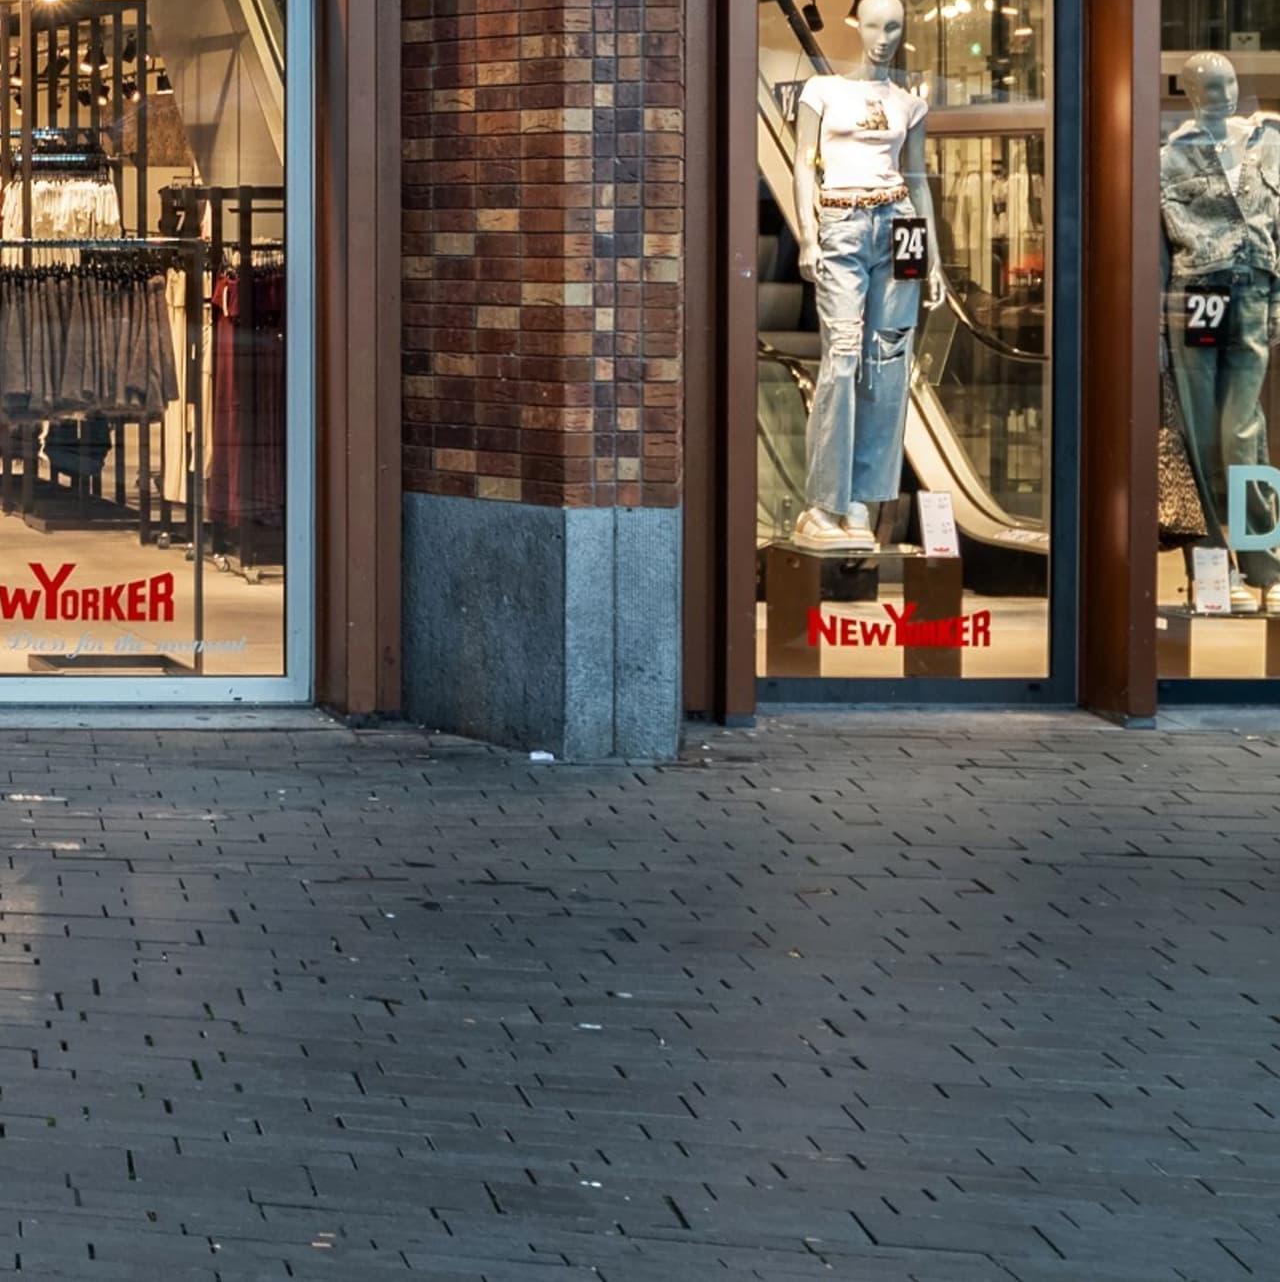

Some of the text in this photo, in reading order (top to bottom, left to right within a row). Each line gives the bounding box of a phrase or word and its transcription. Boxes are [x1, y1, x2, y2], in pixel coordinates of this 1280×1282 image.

[895, 227, 924, 260] 24
[1187, 295, 1225, 329] 29
[808, 602, 991, 648] NEWYER
